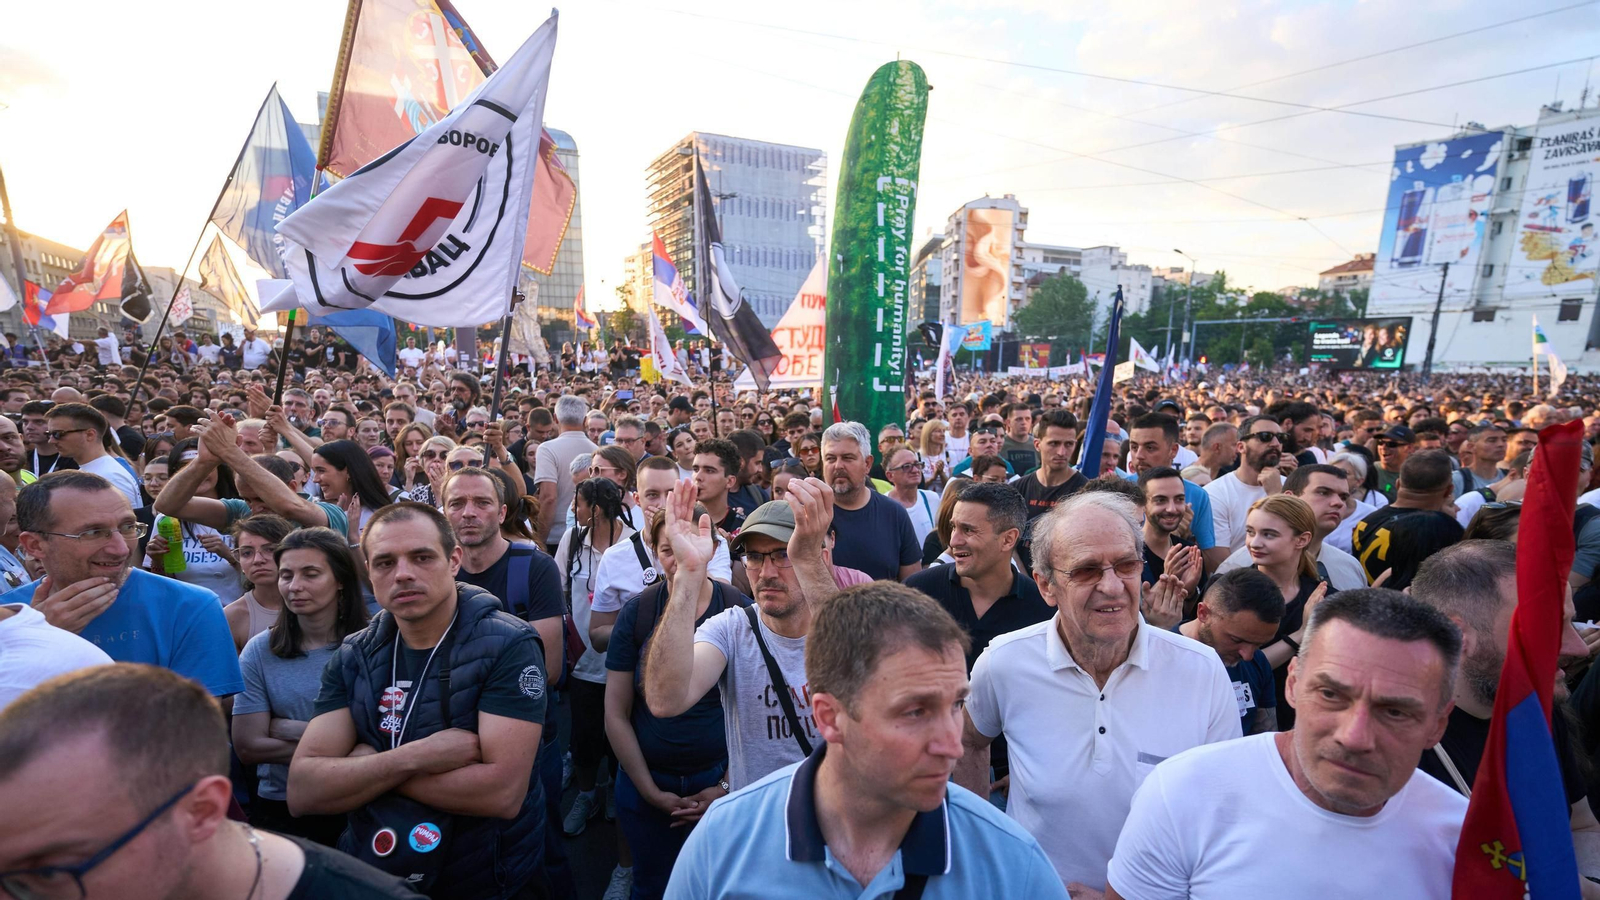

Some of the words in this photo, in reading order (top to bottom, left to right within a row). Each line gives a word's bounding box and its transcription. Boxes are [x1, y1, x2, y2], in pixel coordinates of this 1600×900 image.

[891, 194, 909, 241] Pray
[404, 233, 471, 278] ВАЦ
[894, 246, 908, 275] for
[888, 279, 907, 376] humanity!
[774, 354, 818, 376] ОБЕ
[415, 826, 439, 843] PUMPAJ
